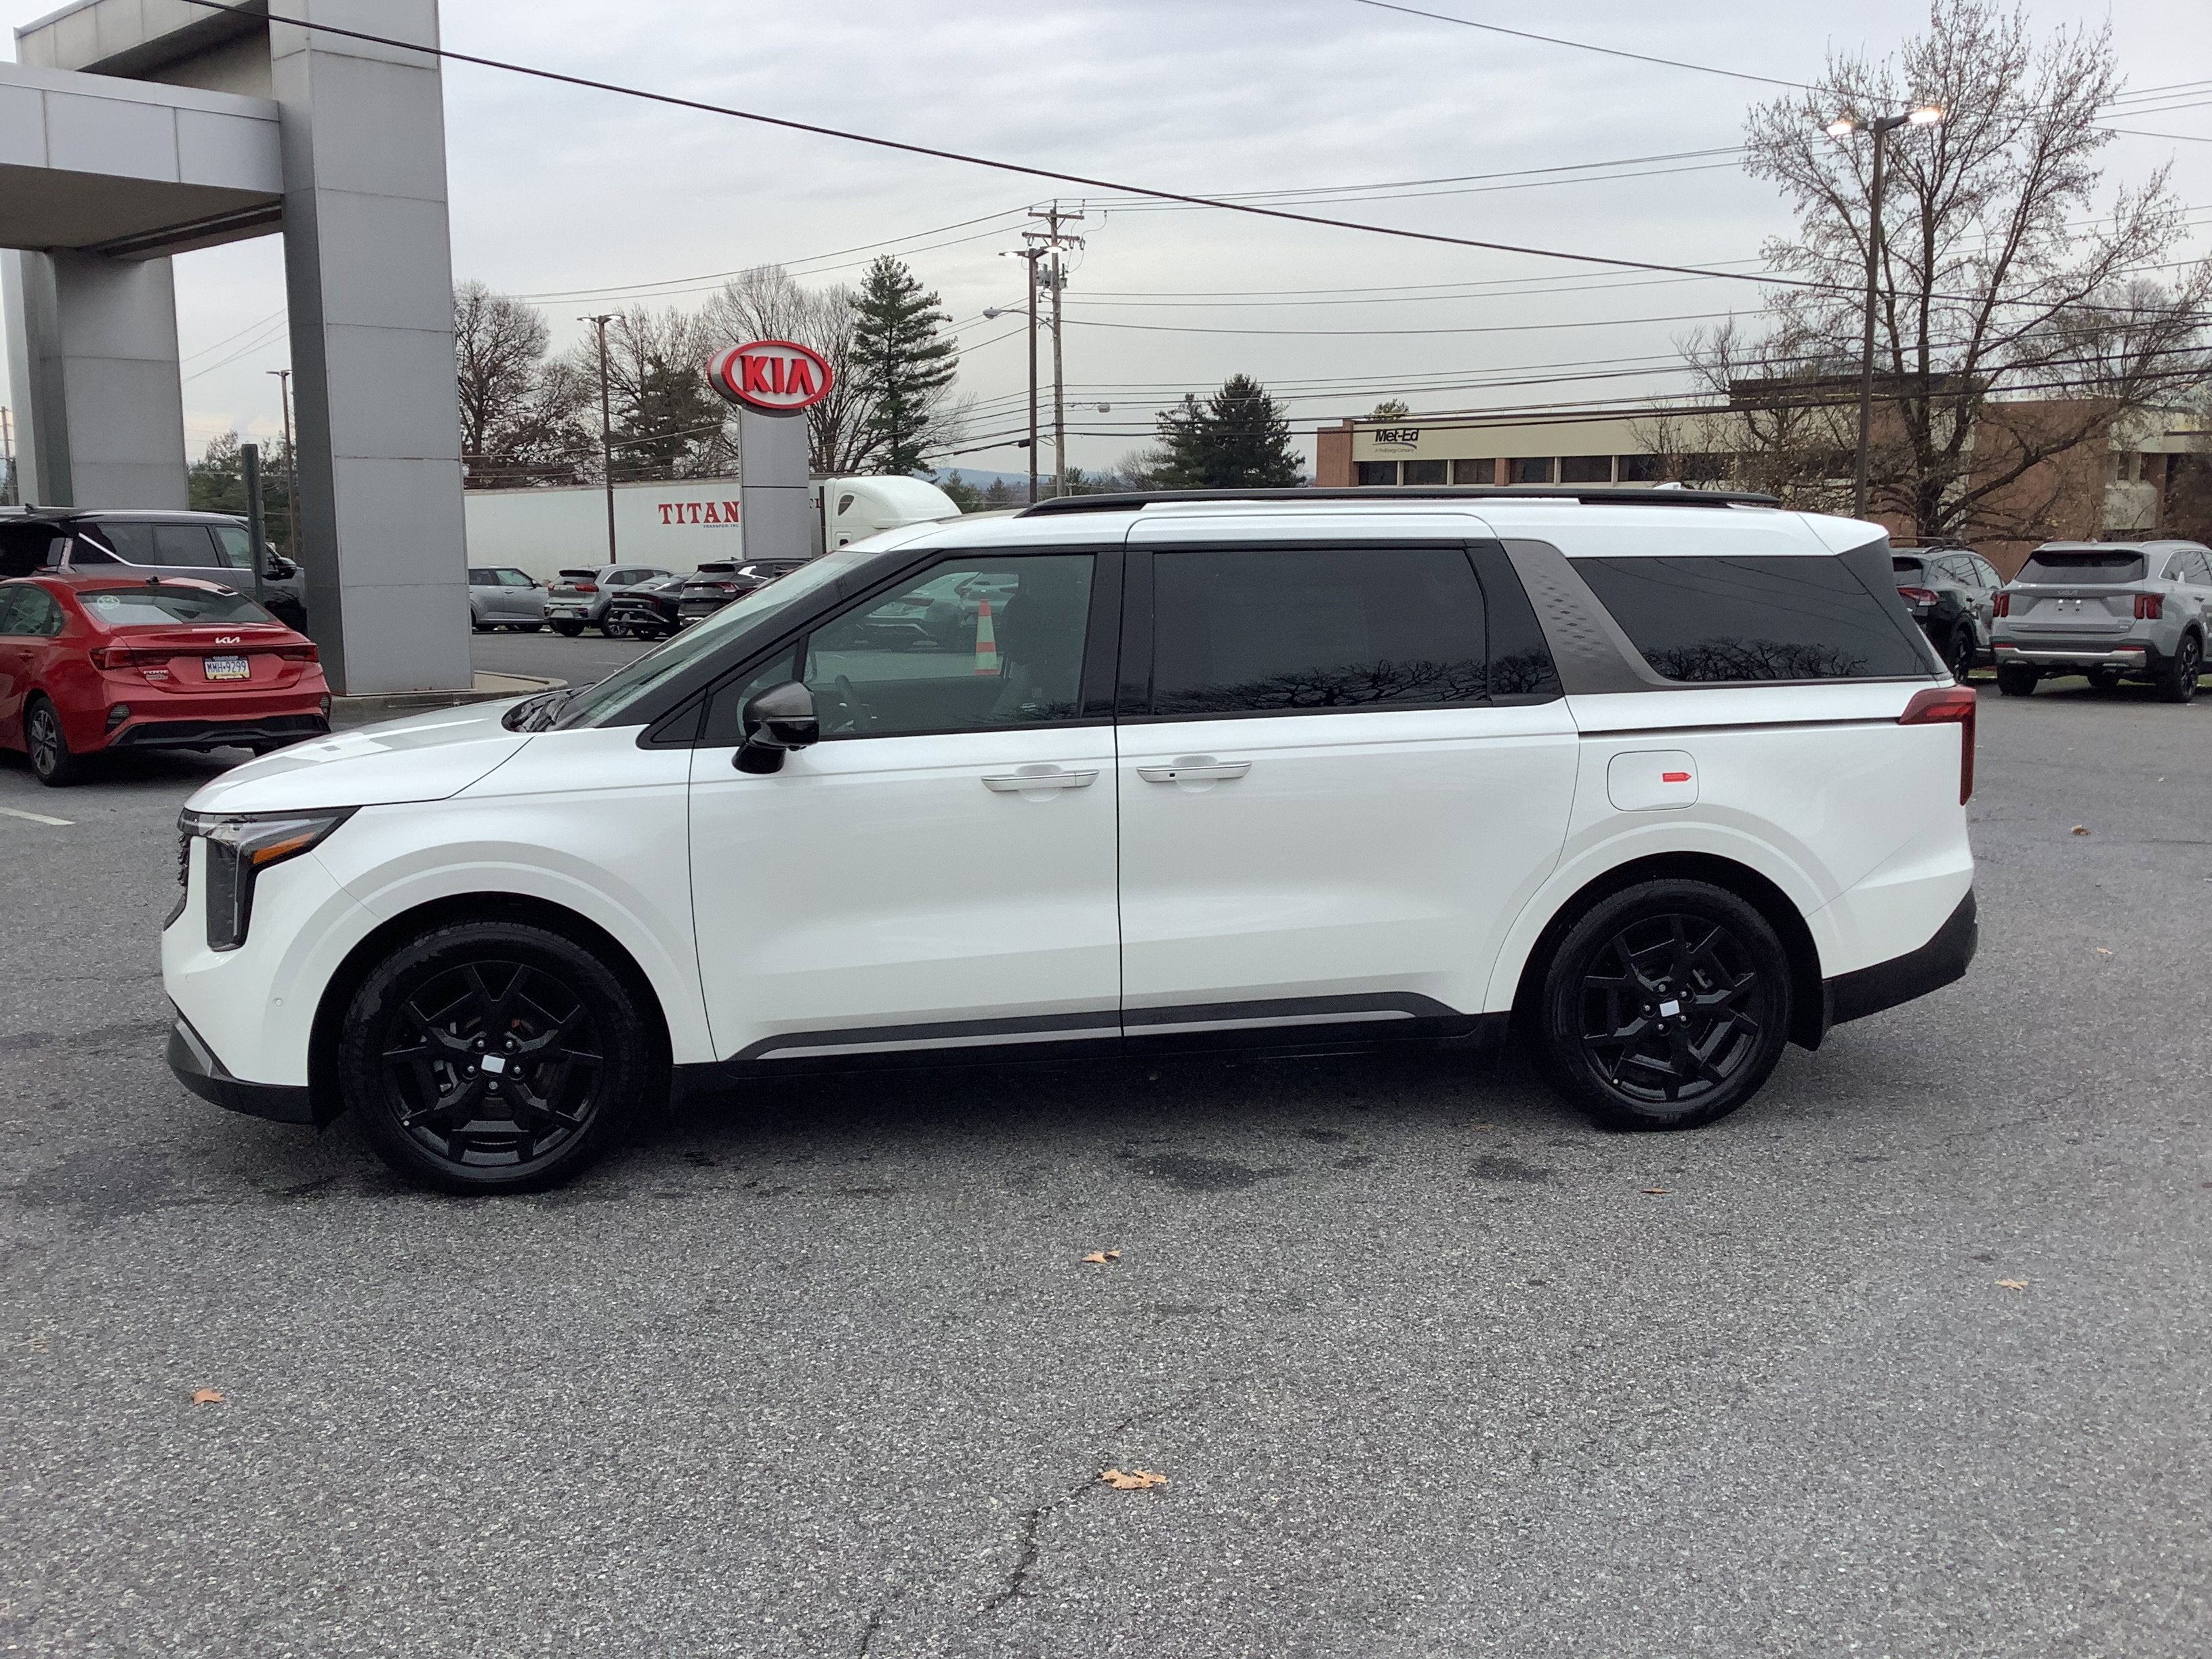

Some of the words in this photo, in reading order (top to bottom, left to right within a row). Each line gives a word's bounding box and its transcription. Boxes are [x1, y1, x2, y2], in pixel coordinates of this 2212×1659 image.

[739, 355, 816, 395] KIA
[1375, 429, 1418, 442] Met-Ed
[658, 501, 740, 524] TITAN
